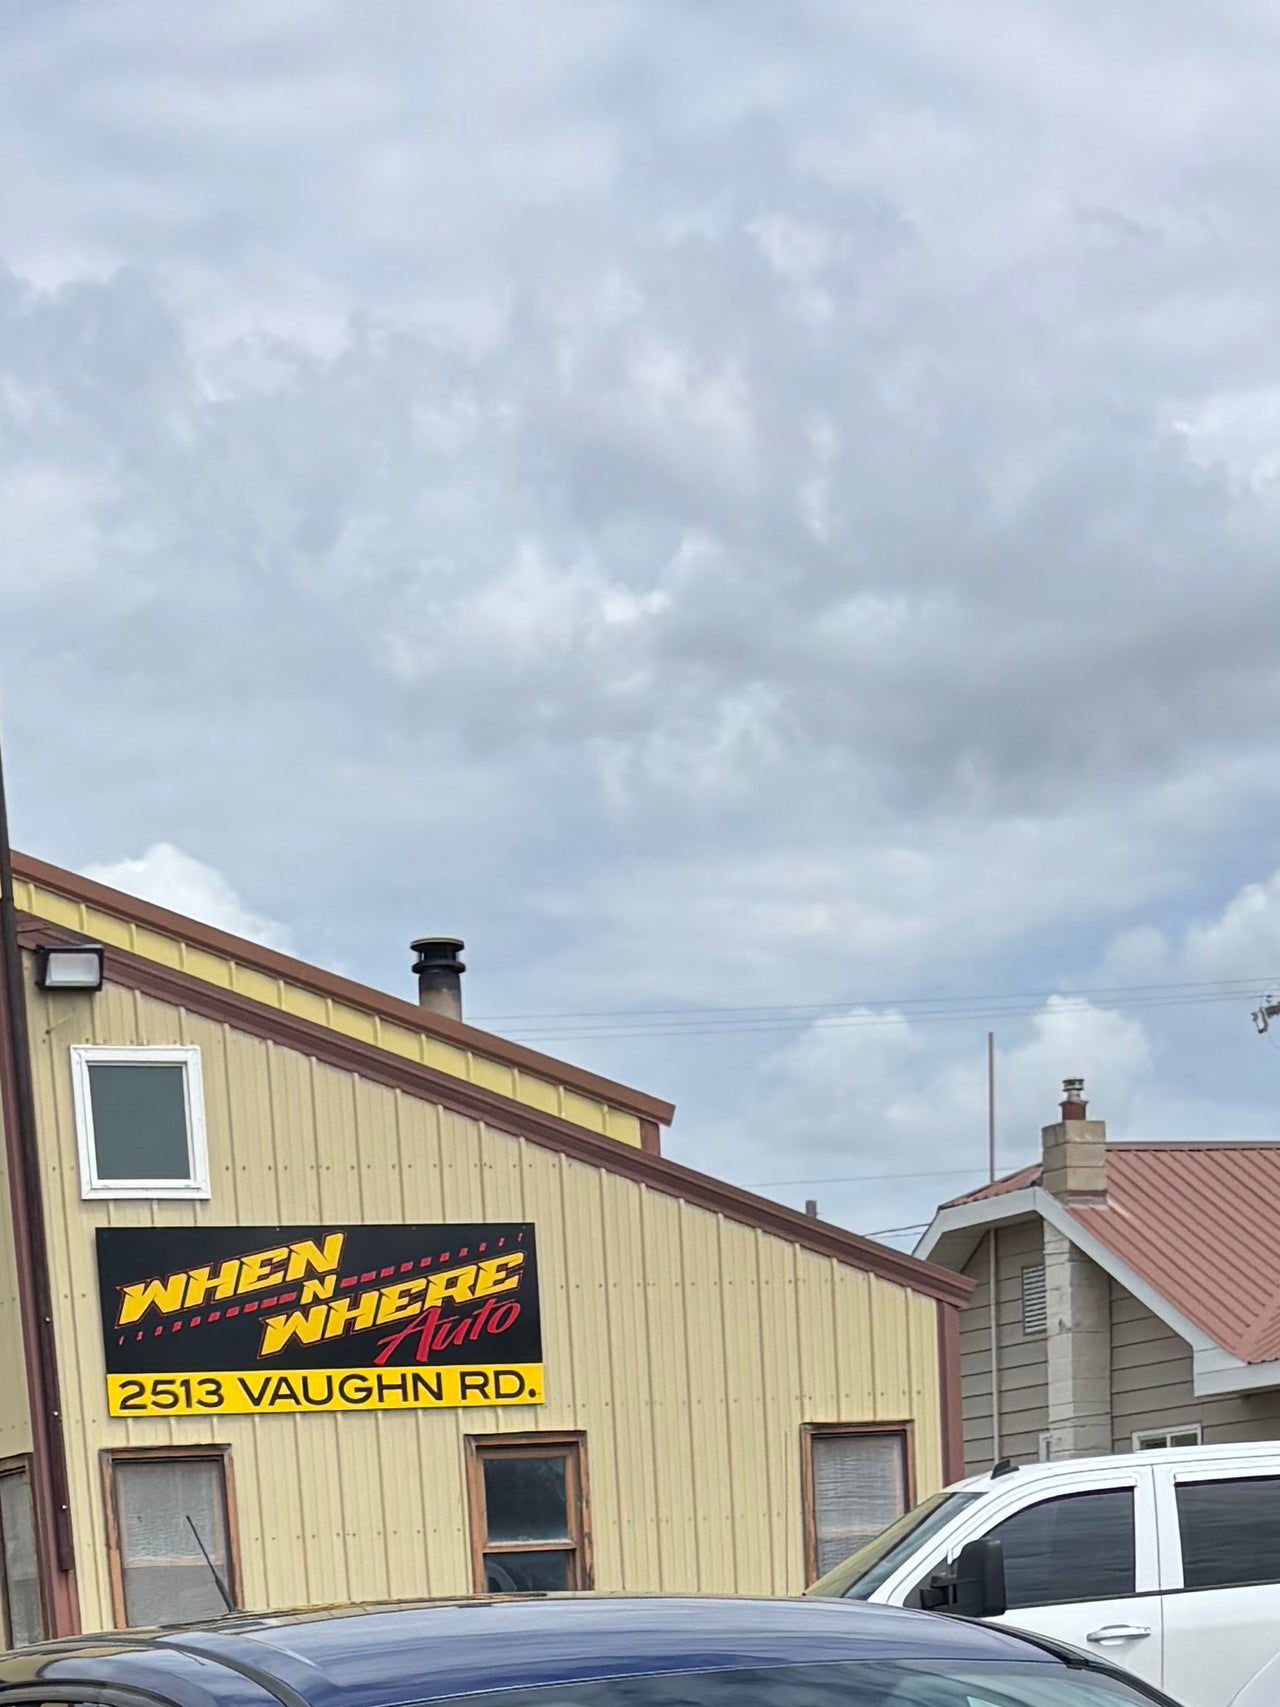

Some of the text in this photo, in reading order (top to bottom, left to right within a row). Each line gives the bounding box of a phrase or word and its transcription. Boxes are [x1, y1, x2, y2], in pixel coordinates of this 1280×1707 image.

[117, 1232, 345, 1326] WHEN
[259, 1251, 525, 1357] WHERE
[300, 1274, 337, 1305] N
[373, 1298, 520, 1366] Auto
[118, 1369, 537, 1410] 2513 VAUGHN RD.
